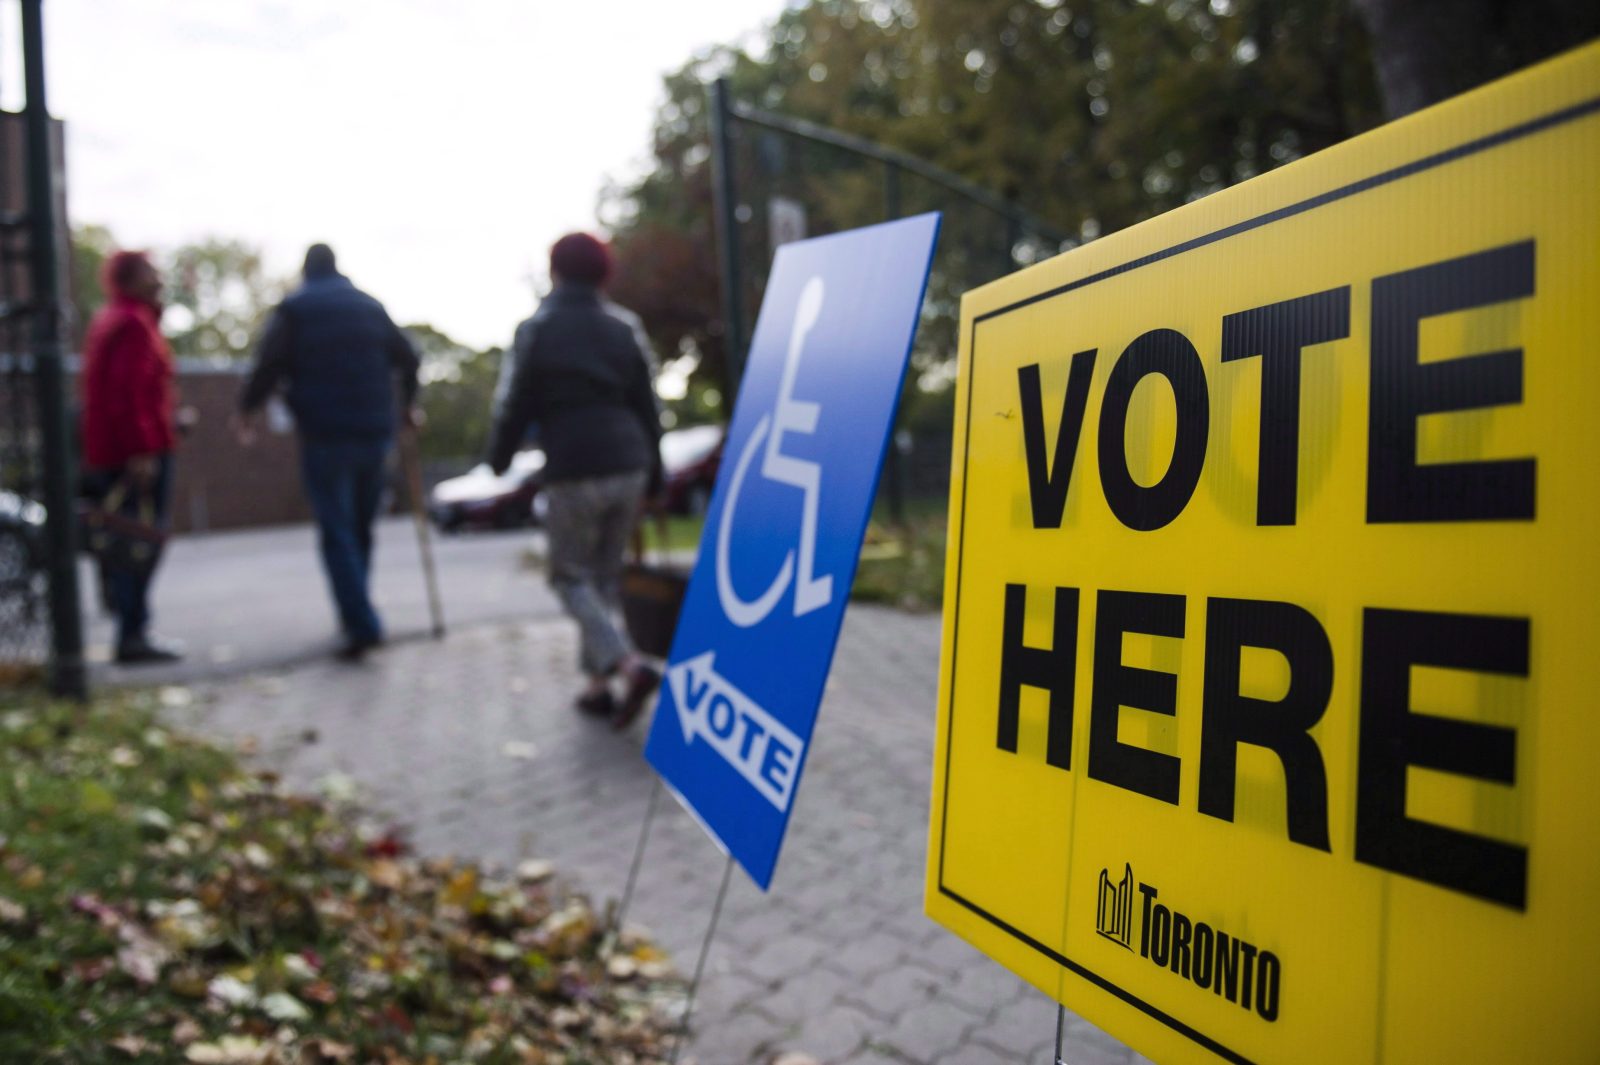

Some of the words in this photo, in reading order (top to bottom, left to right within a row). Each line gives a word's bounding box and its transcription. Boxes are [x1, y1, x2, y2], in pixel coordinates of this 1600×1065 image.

[1018, 237, 1537, 531] VOTE
[685, 667, 794, 795] VOTE
[996, 583, 1531, 913] HERE
[1139, 882, 1281, 1022] TORONTO
